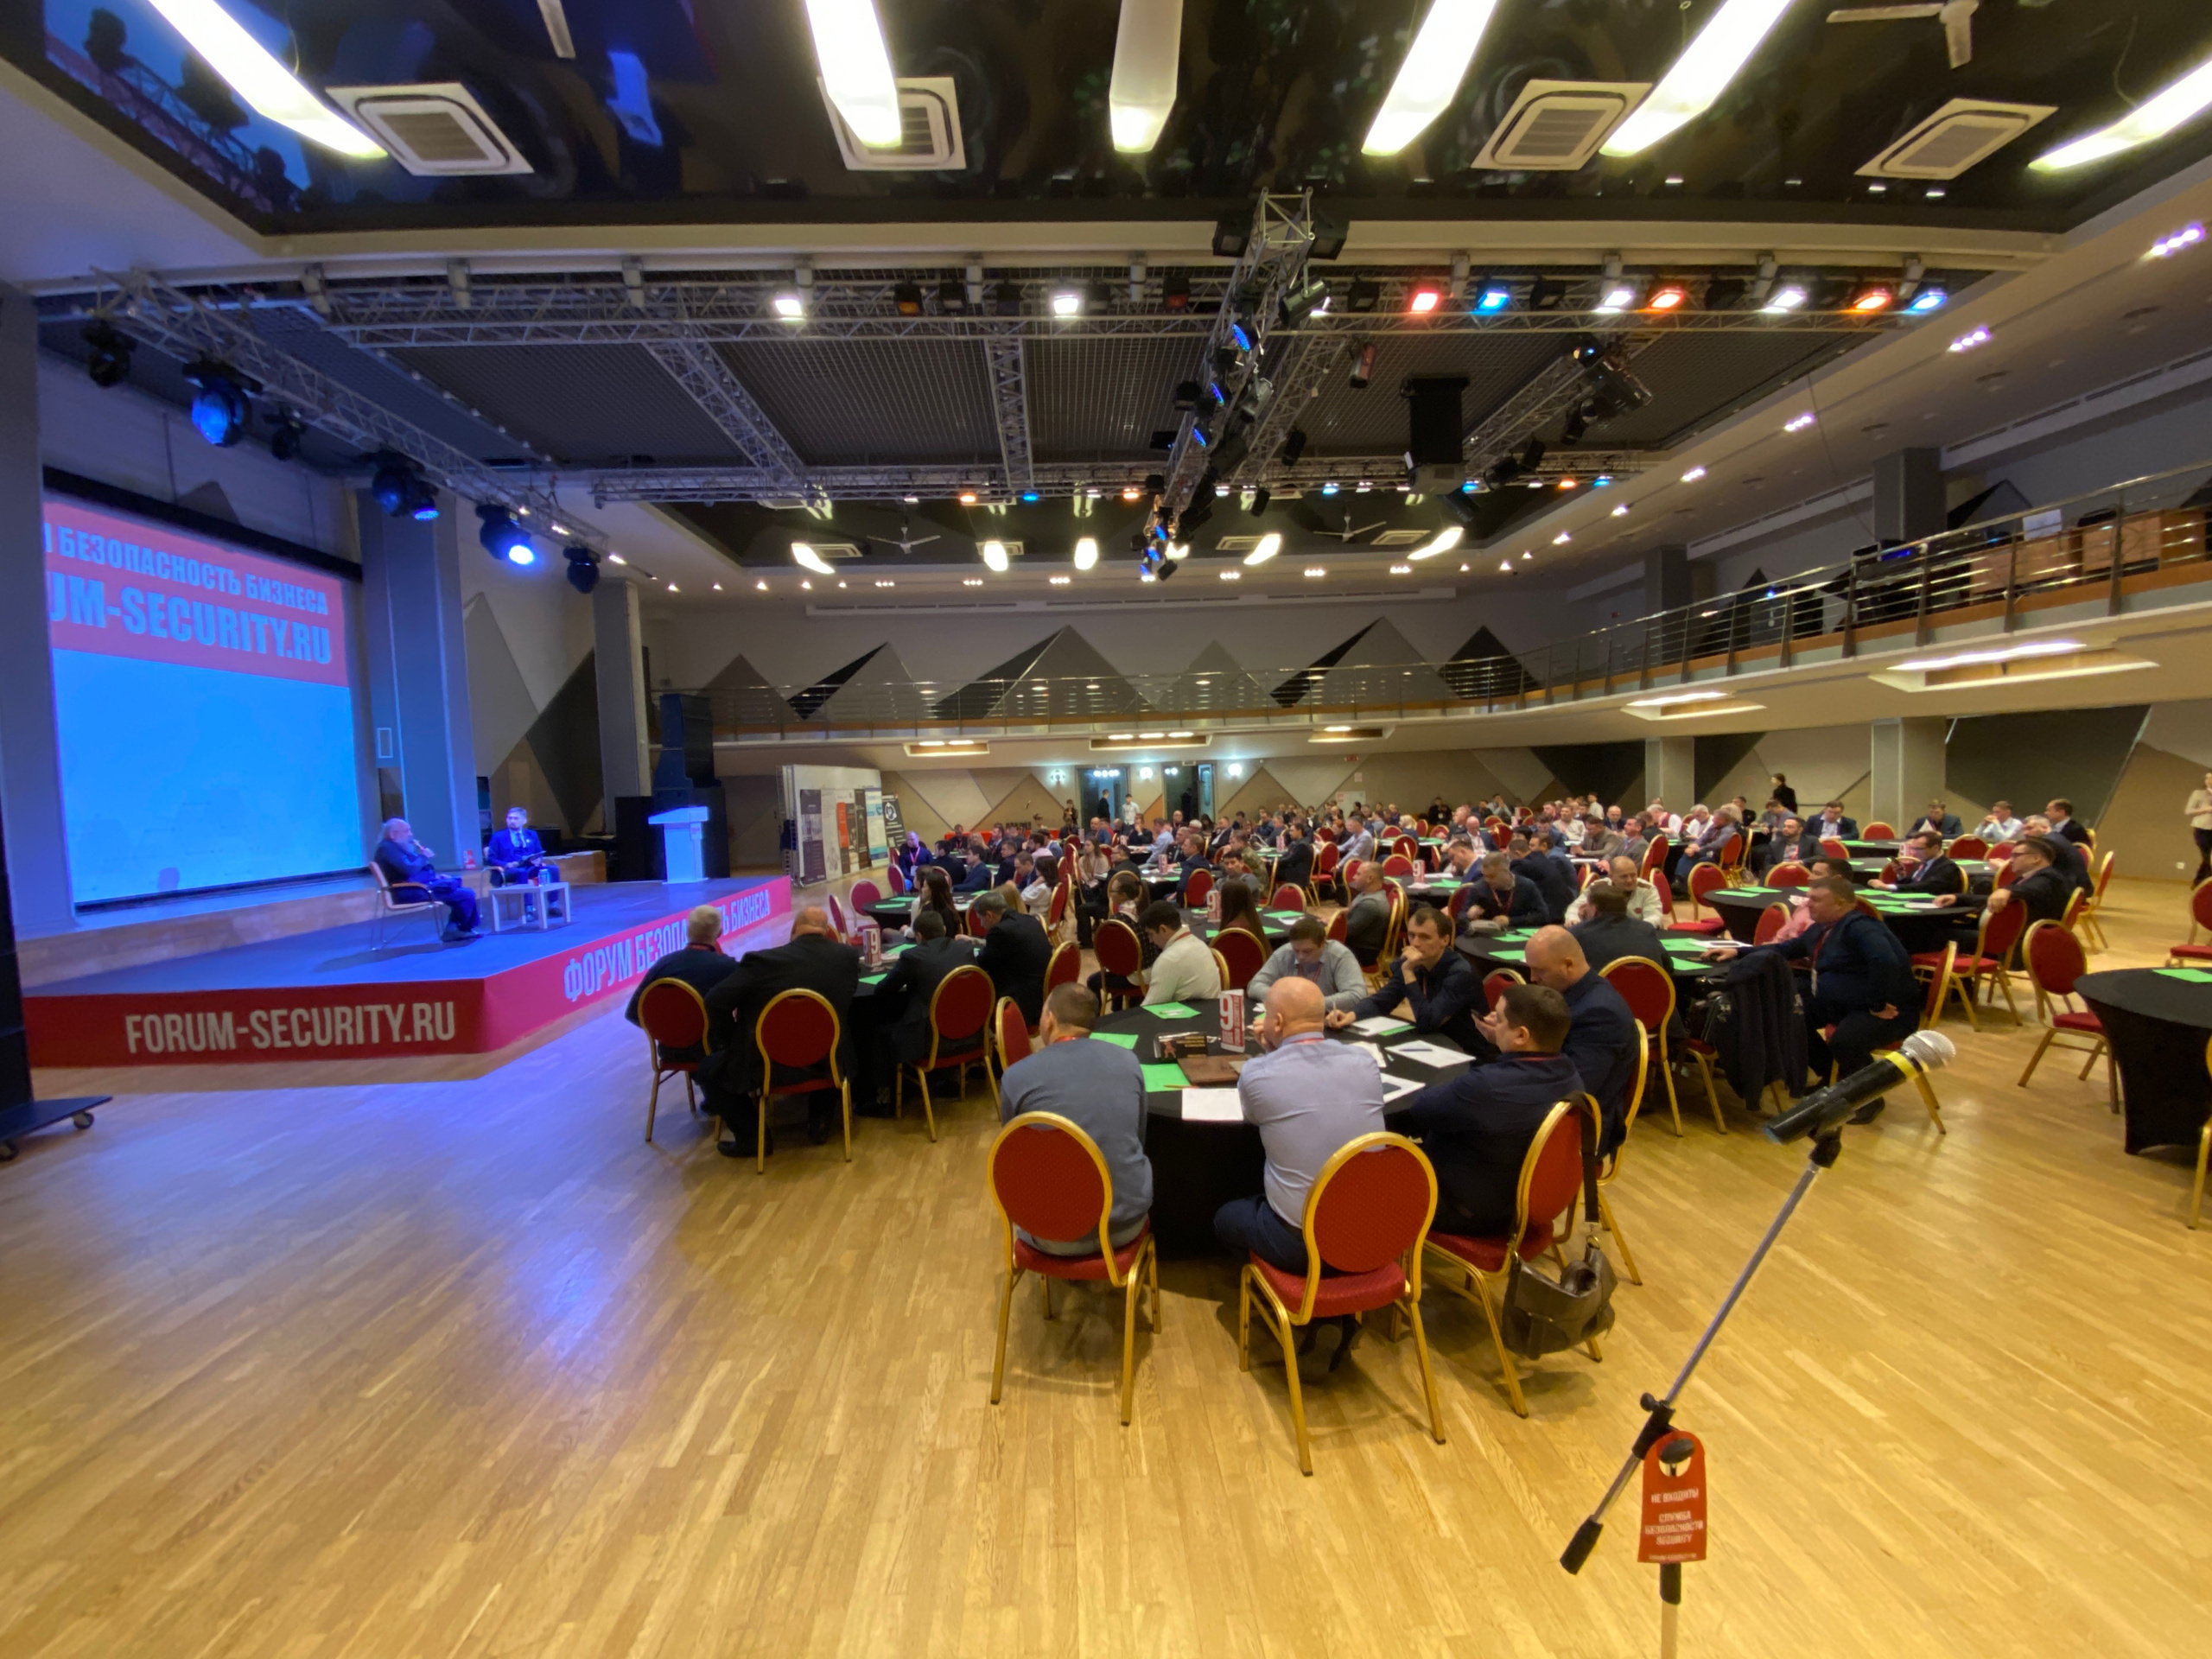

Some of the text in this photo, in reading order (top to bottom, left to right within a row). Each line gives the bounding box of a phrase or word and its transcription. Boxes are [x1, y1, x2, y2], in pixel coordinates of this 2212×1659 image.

[58, 526, 240, 595] БЕЗОПАСНОСТЬ
[245, 574, 328, 615] БИЗНЕСА
[1206, 891, 1217, 912] 9
[563, 938, 632, 1002] ФОРУМ
[730, 889, 771, 932] БИЗНЕСА
[870, 930, 879, 955] 9
[124, 1001, 456, 1054] FORUM-SECURITY.RU
[1219, 993, 1234, 1031] 9
[1650, 1494, 1662, 1503] НЕ
